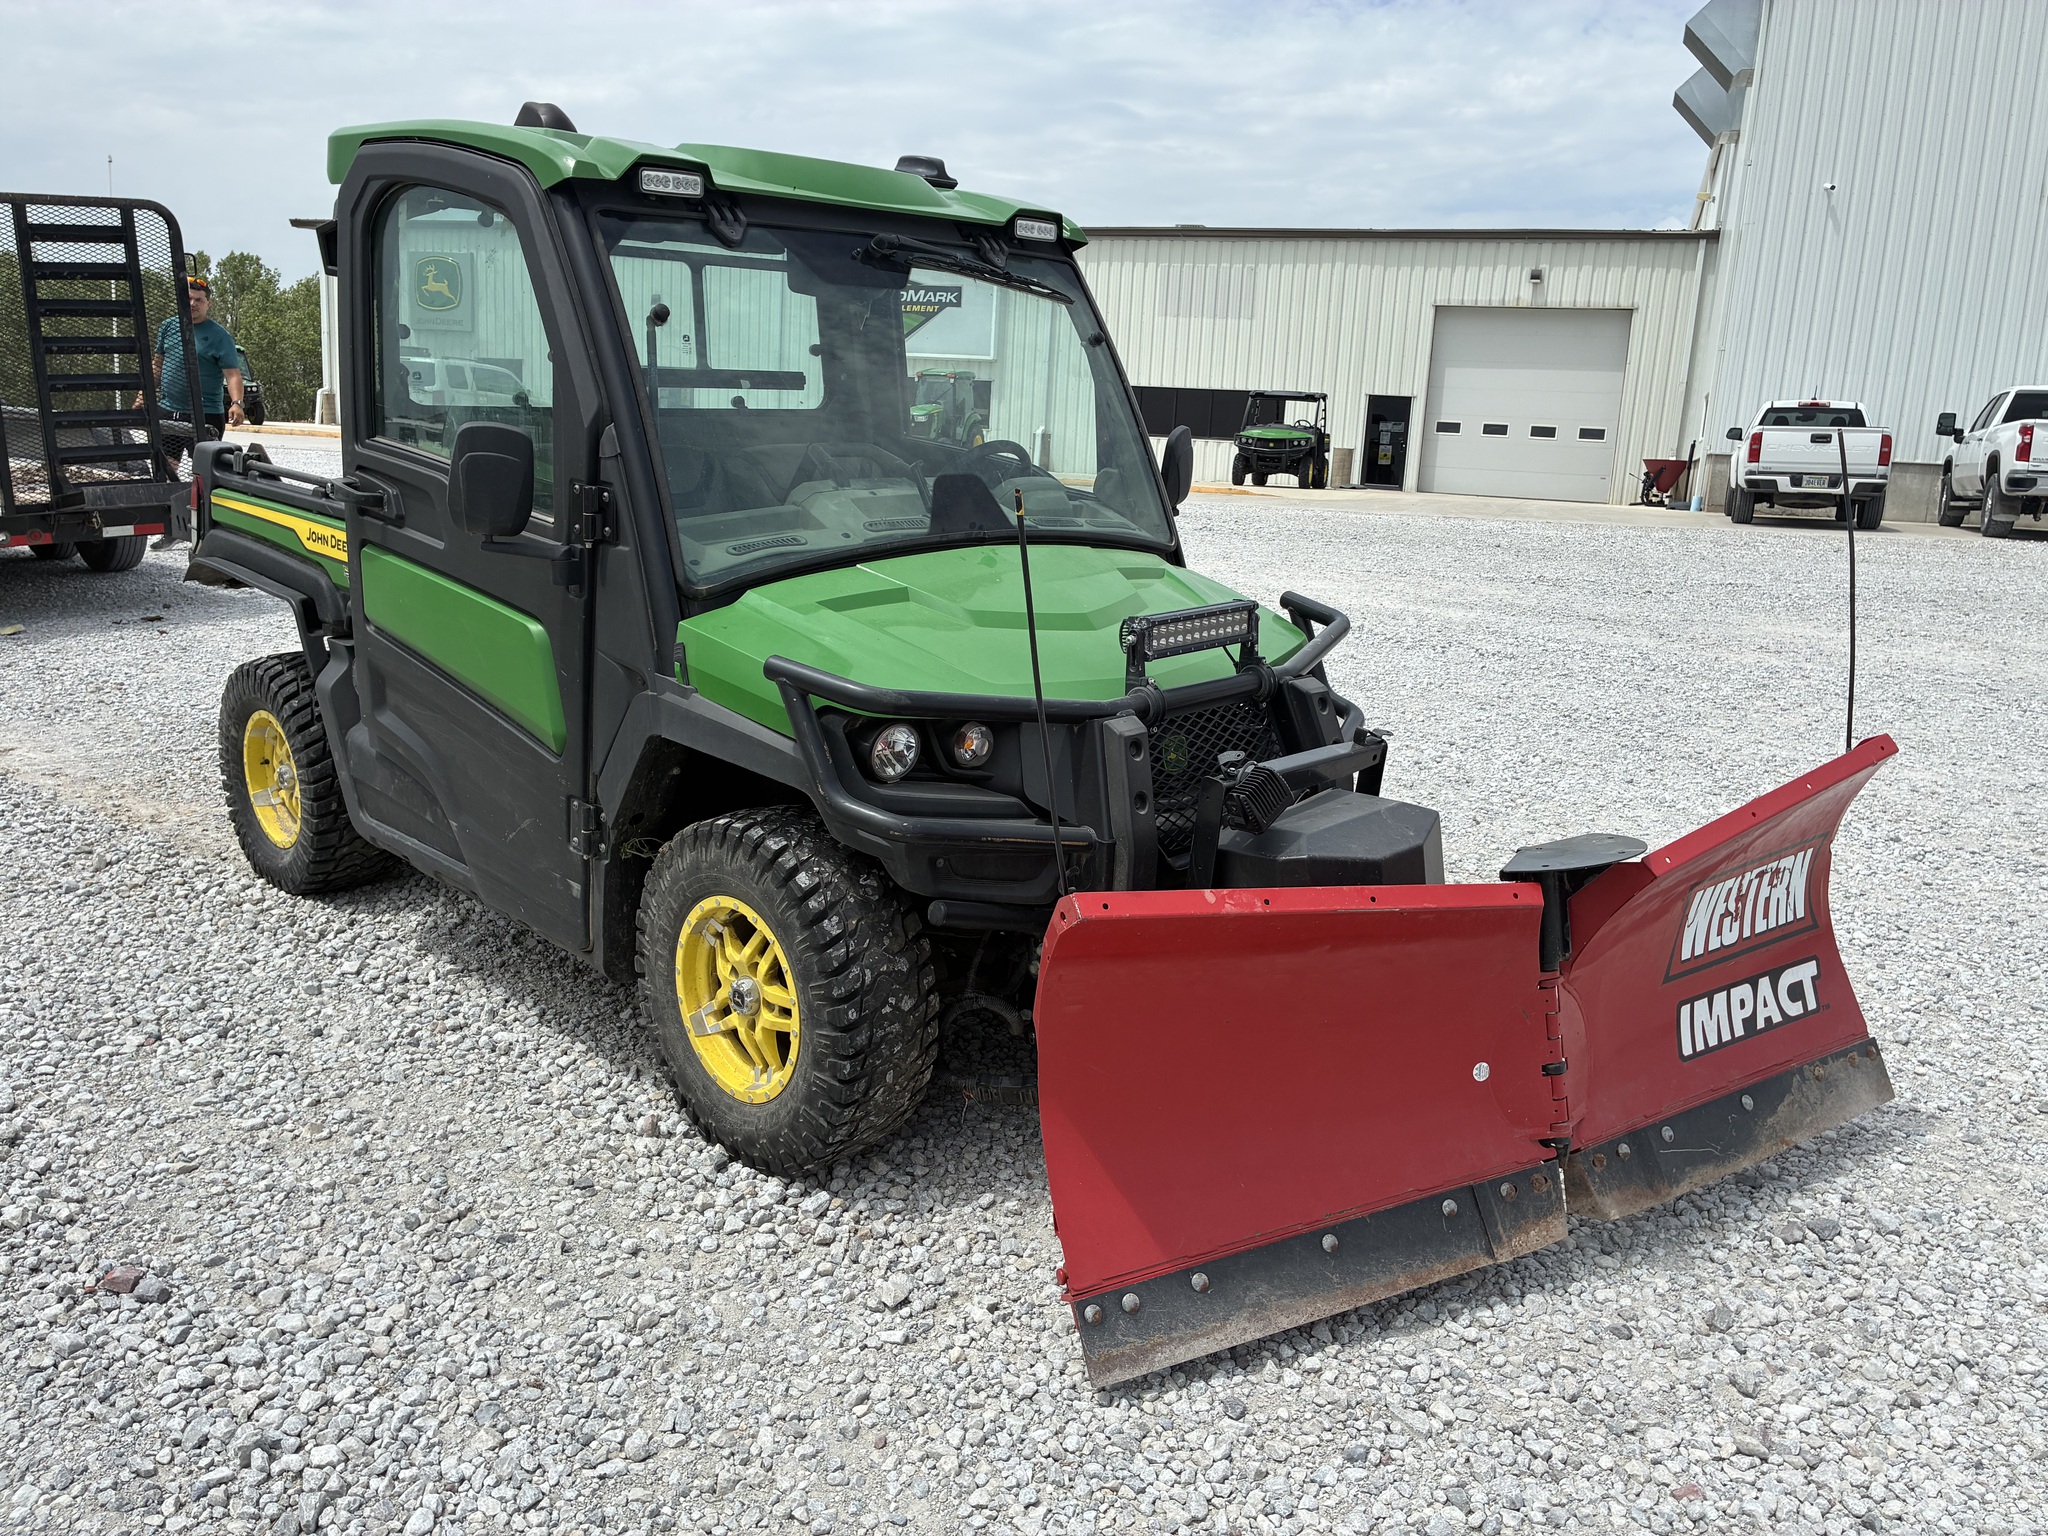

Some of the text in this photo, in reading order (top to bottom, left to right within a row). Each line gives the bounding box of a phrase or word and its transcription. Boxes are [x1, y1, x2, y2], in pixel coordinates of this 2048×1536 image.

[306, 527, 329, 546] JOHN
[1680, 847, 1814, 962] WESTERN
[1679, 959, 1818, 1057] IMPACT
